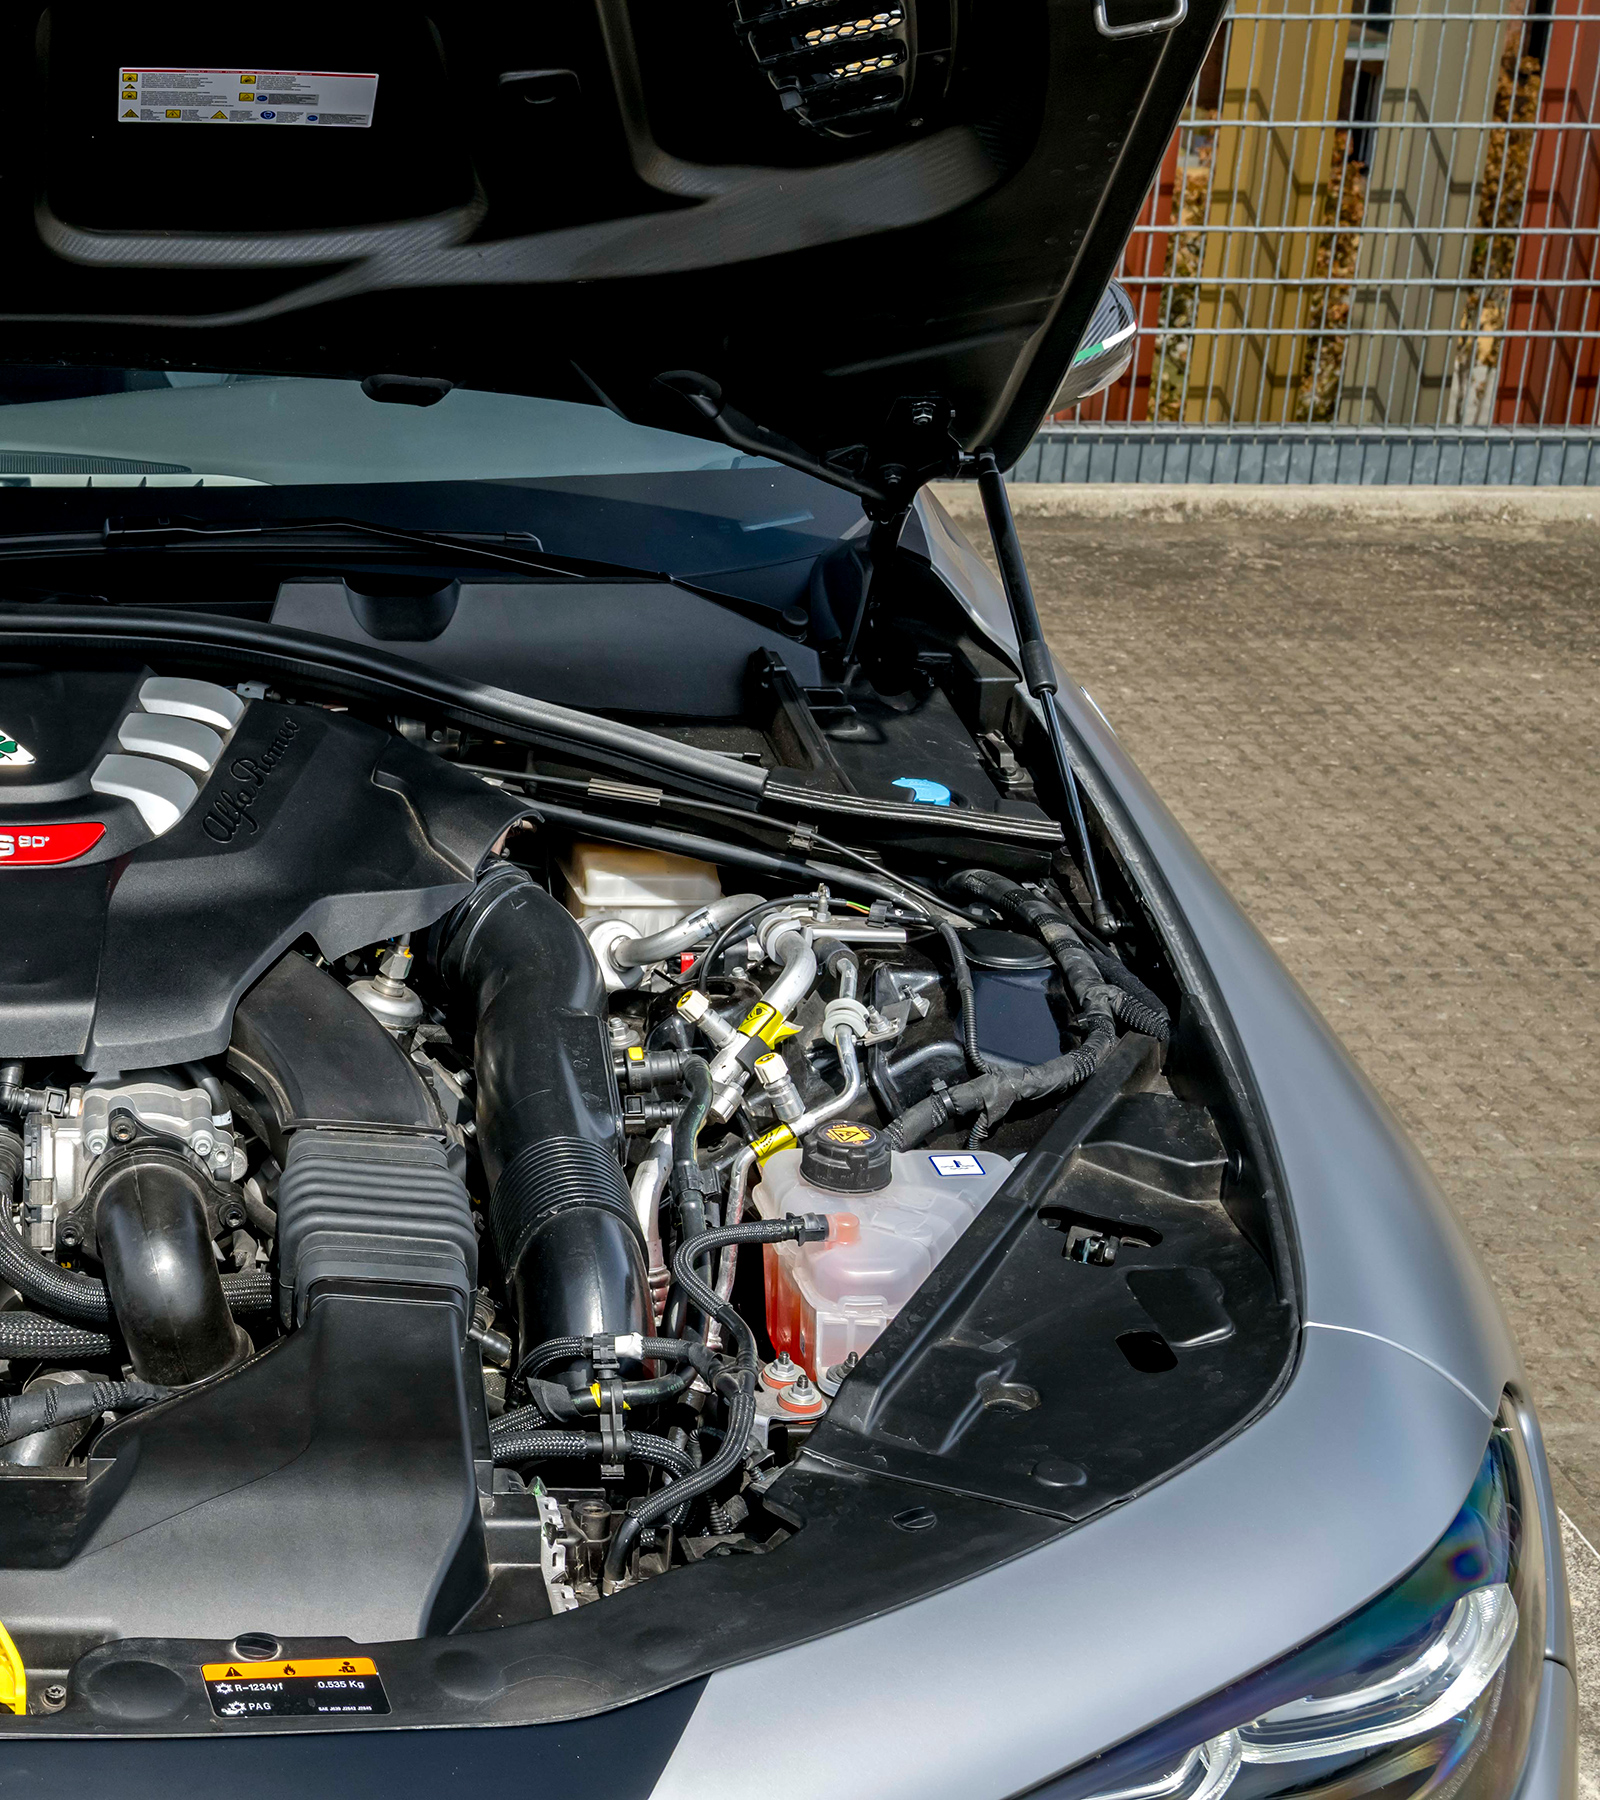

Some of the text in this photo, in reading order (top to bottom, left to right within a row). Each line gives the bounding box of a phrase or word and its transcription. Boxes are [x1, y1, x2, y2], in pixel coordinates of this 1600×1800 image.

[202, 716, 300, 844] Alfa Romeo
[234, 1680, 365, 1692] R-1234yf 0.535 Kg
[248, 1702, 272, 1711] PAG
